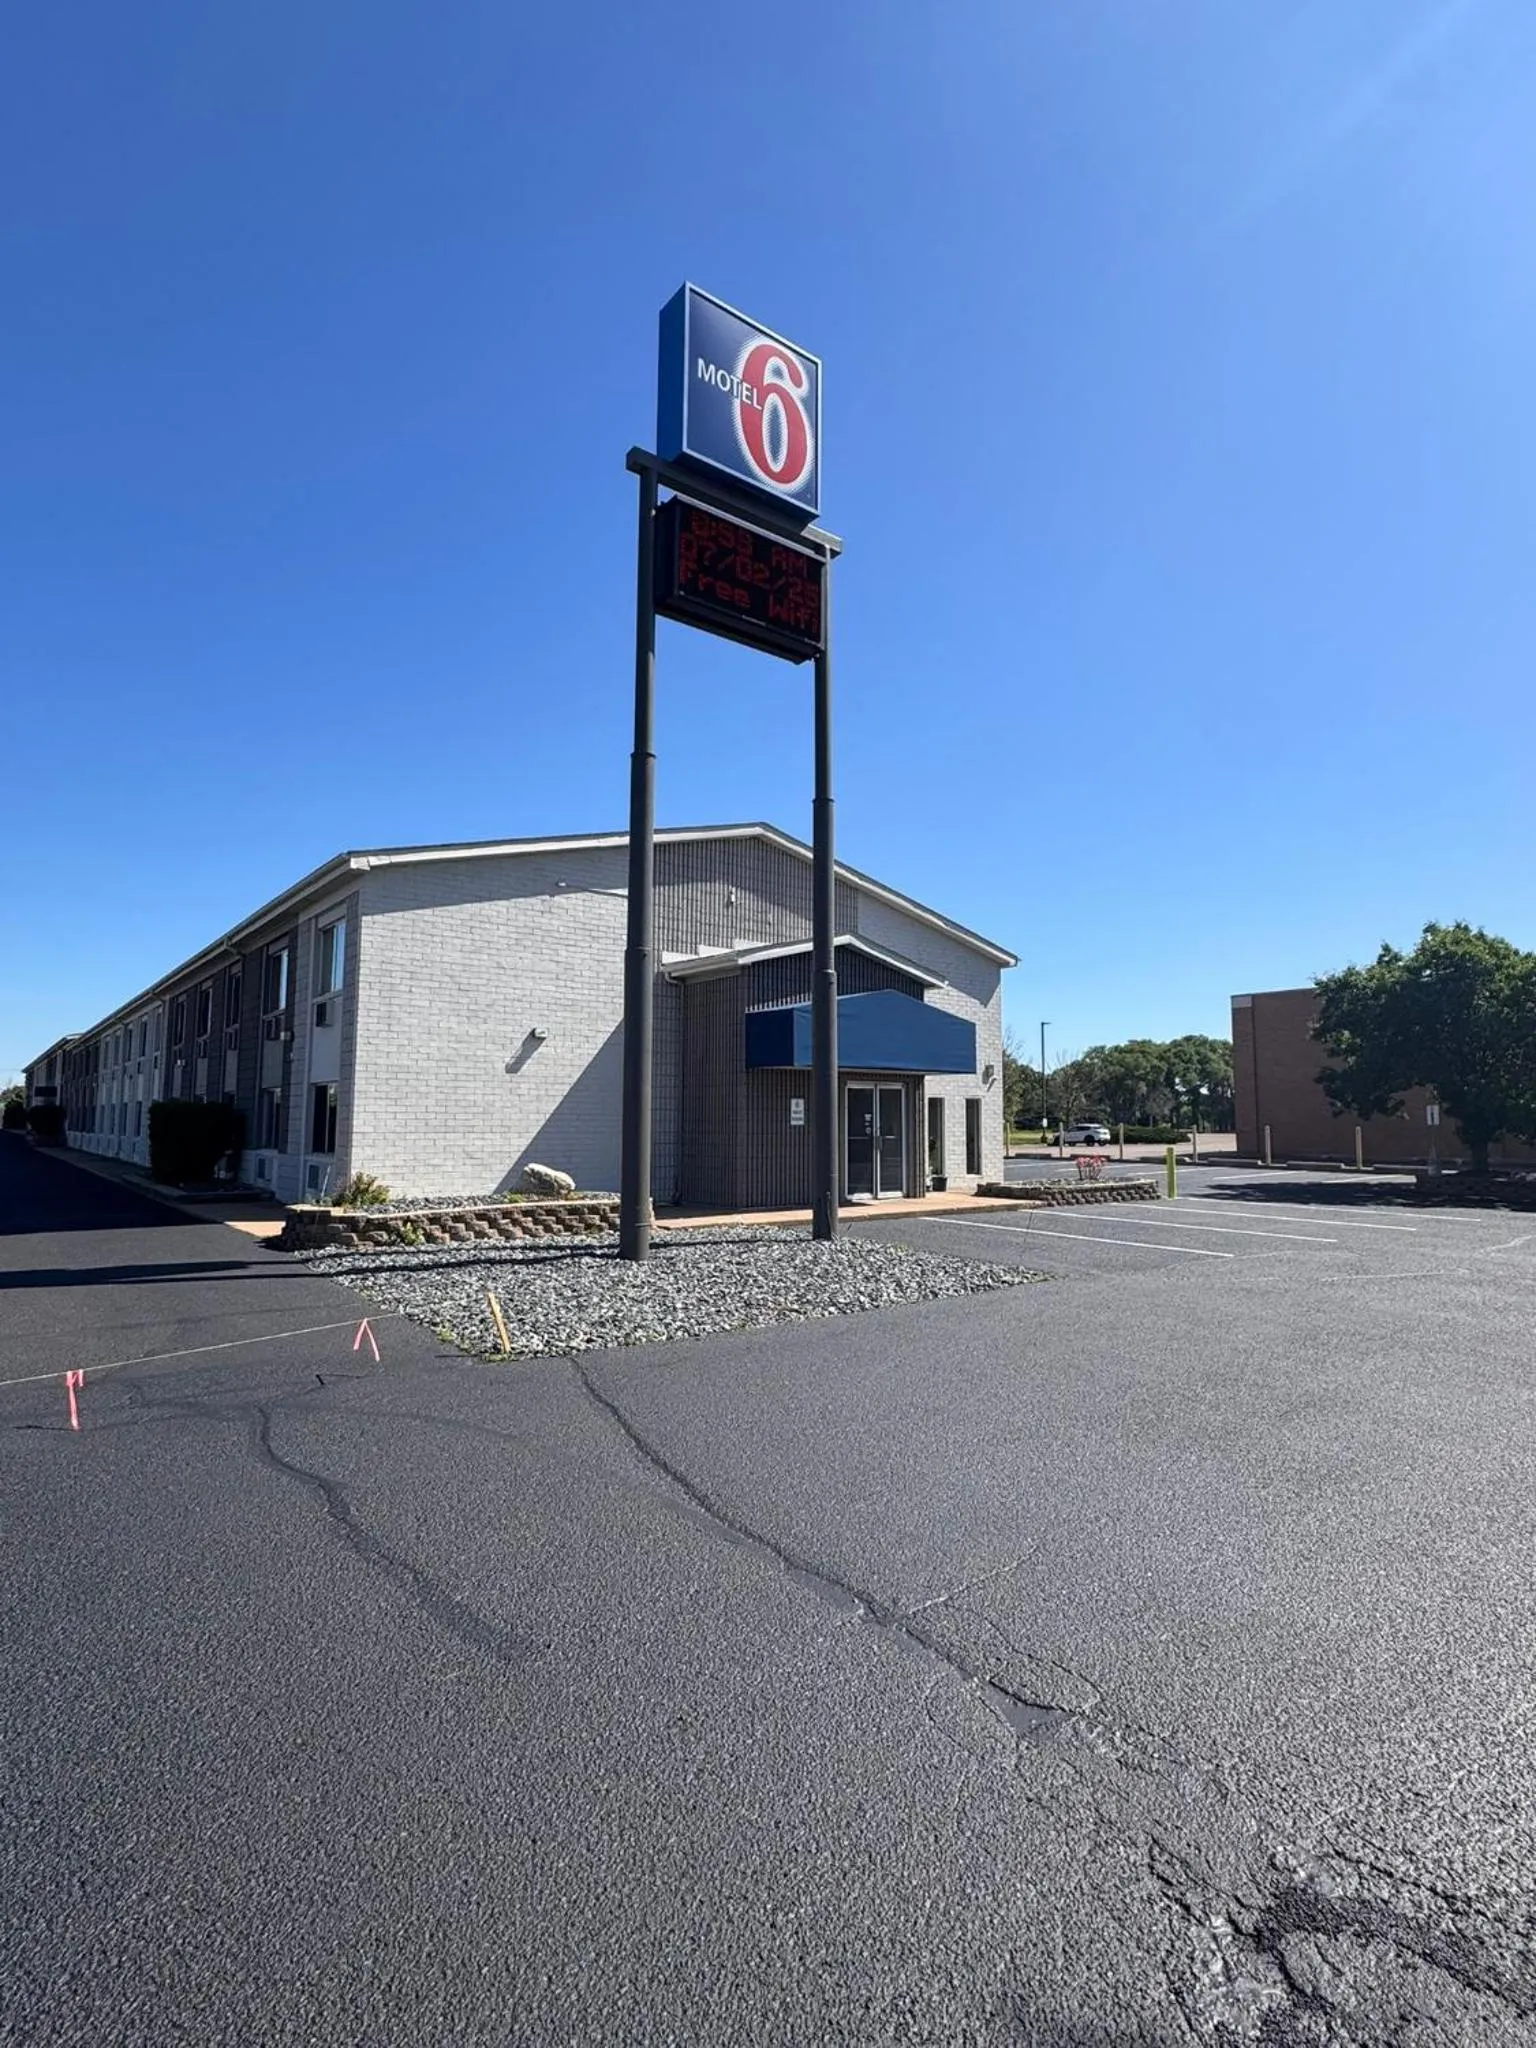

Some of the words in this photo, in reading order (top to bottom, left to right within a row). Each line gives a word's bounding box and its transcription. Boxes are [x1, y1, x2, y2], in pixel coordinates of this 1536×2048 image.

[698, 357, 763, 411] MOTEL
[739, 341, 809, 487] 6
[679, 557, 751, 608] Free
